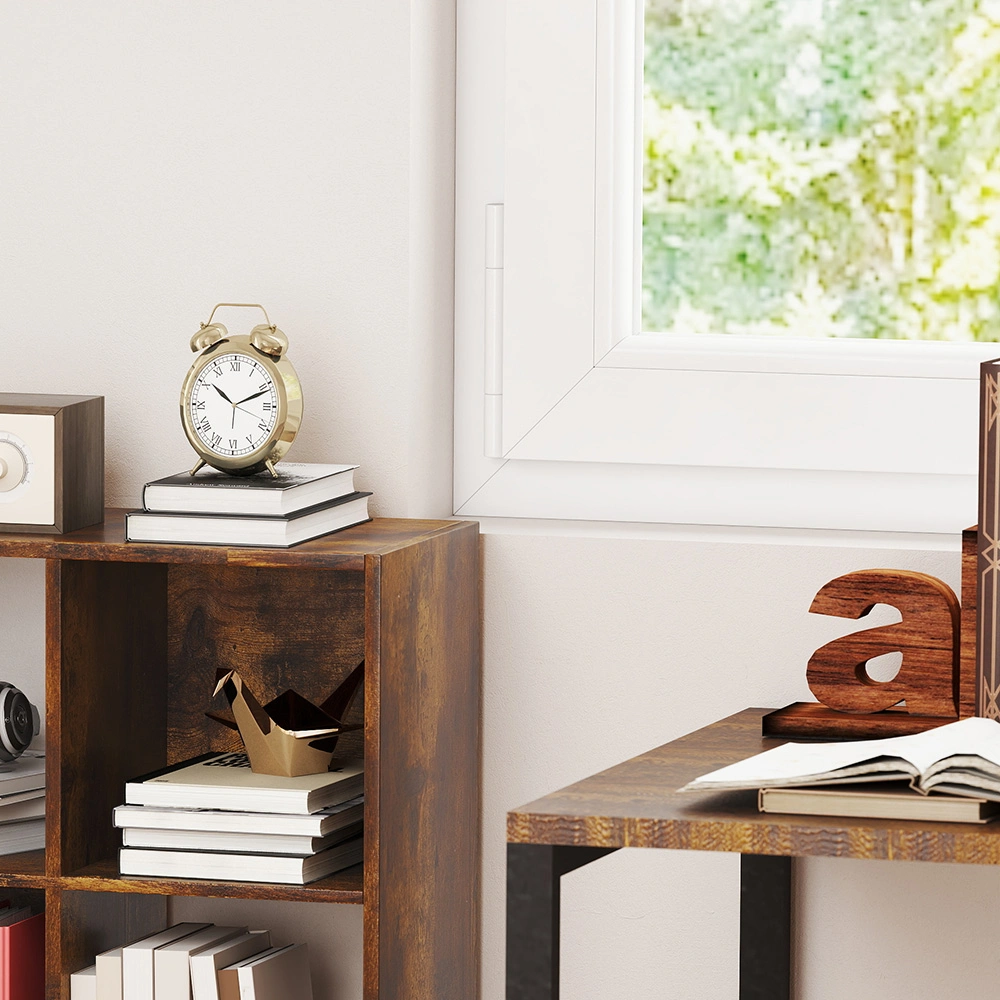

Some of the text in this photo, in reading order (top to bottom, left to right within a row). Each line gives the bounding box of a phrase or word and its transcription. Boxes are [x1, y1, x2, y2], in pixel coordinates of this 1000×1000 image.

[230, 361, 240, 372] XII
[228, 439, 238, 449] VI
[806, 568, 961, 717] a
